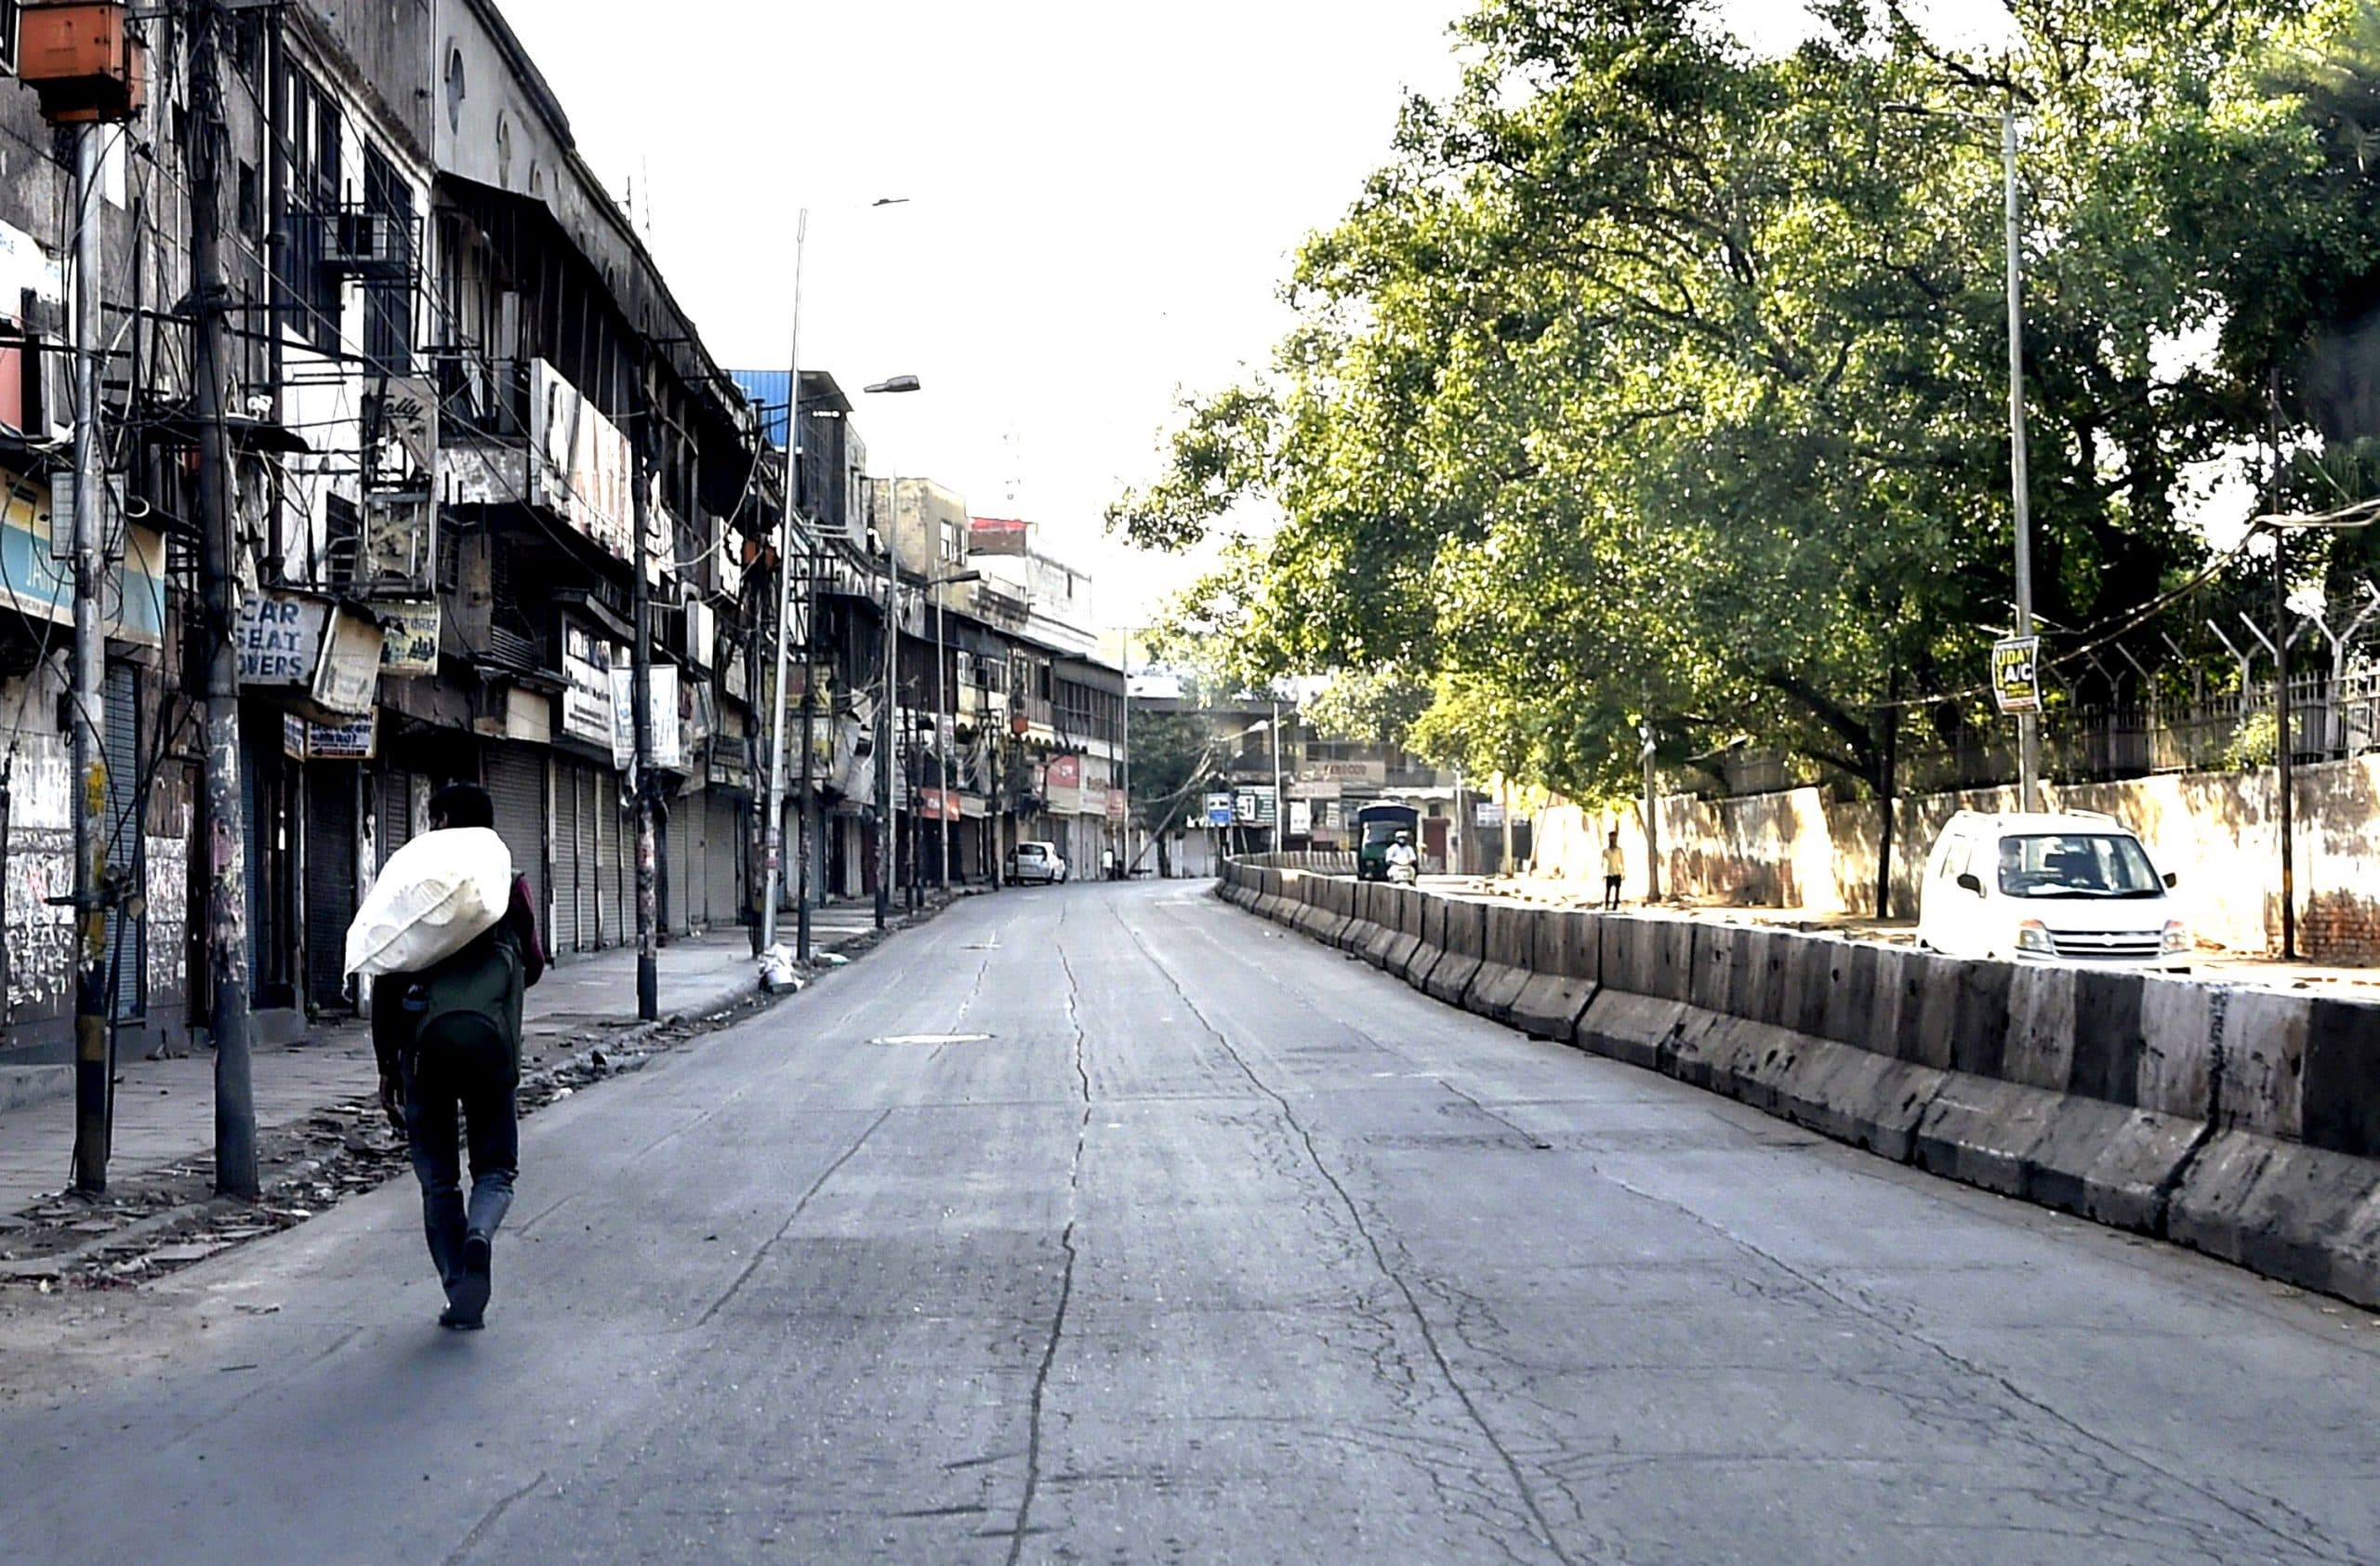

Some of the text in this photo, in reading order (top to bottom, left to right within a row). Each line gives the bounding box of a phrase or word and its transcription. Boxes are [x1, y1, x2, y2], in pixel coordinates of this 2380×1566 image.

[242, 599, 299, 624] CAR
[237, 654, 303, 677] OVERS
[1996, 647, 2032, 666] UDAY
[2004, 662, 2033, 683] A/C
